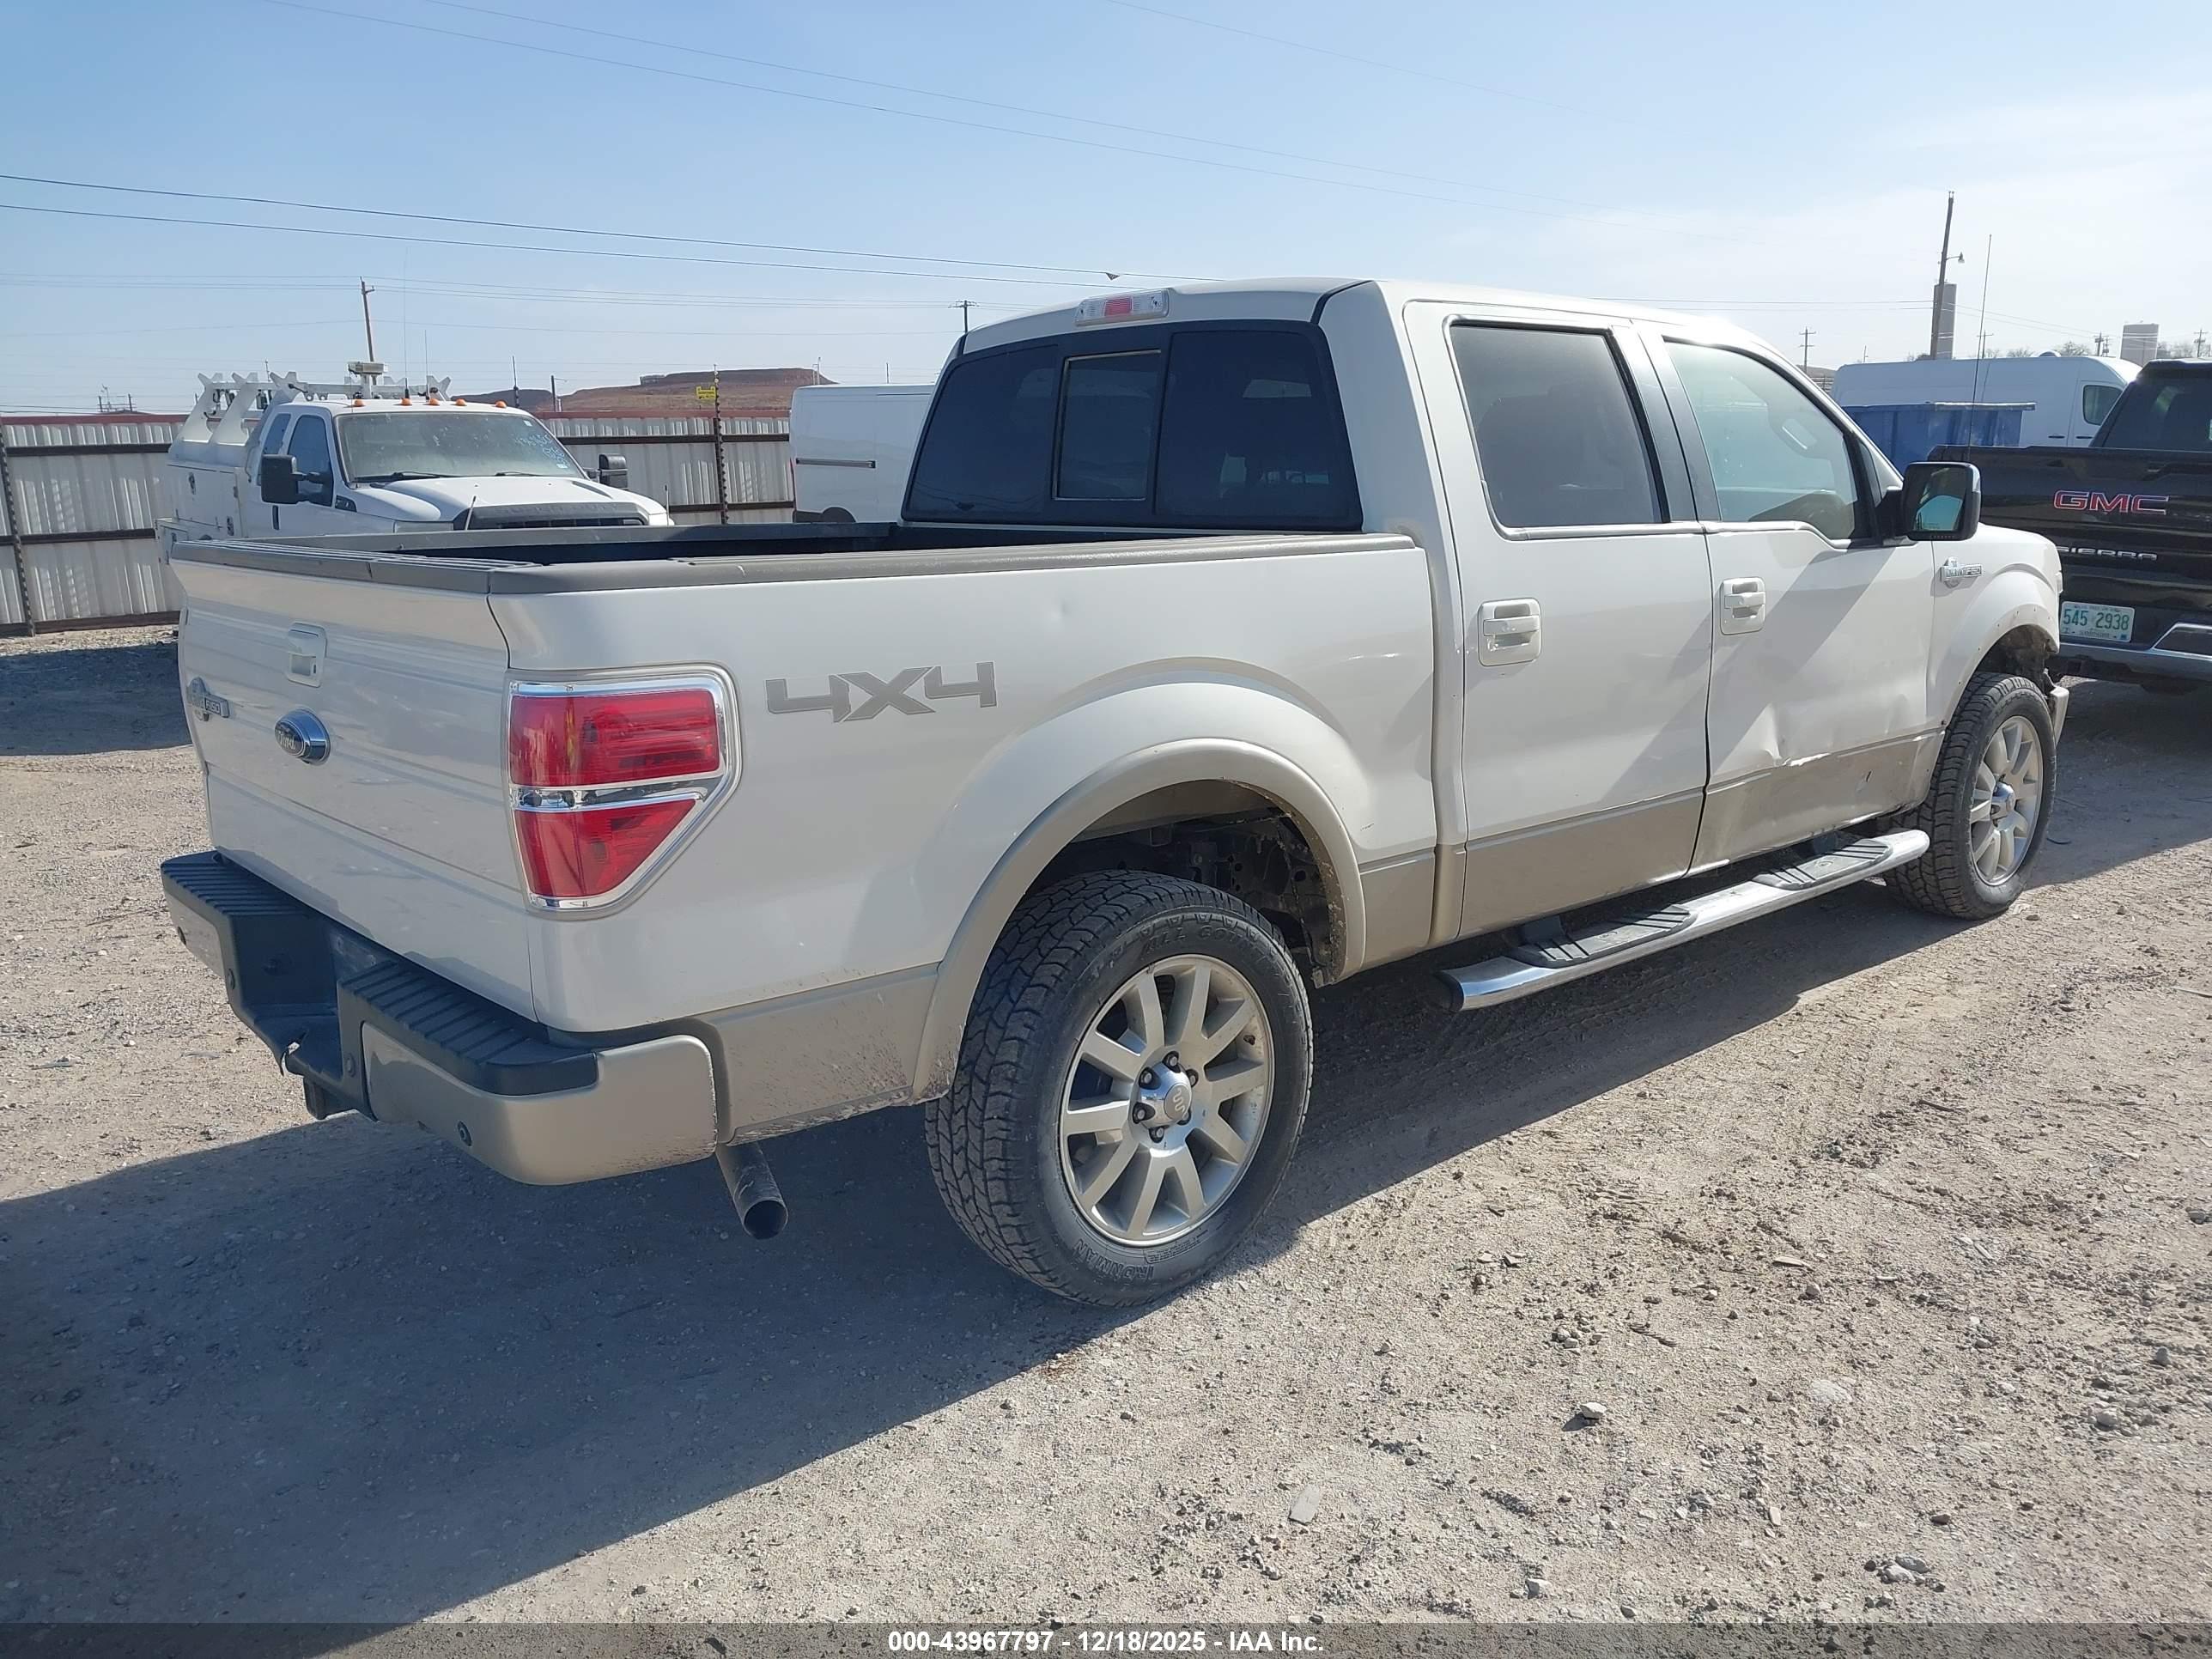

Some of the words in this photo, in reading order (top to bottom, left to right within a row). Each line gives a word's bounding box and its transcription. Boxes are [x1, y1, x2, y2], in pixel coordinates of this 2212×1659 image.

[2053, 489, 2169, 515] GMC
[2063, 609, 2089, 627] 545
[2095, 611, 2130, 631] 2938
[765, 660, 998, 723] 4X4
